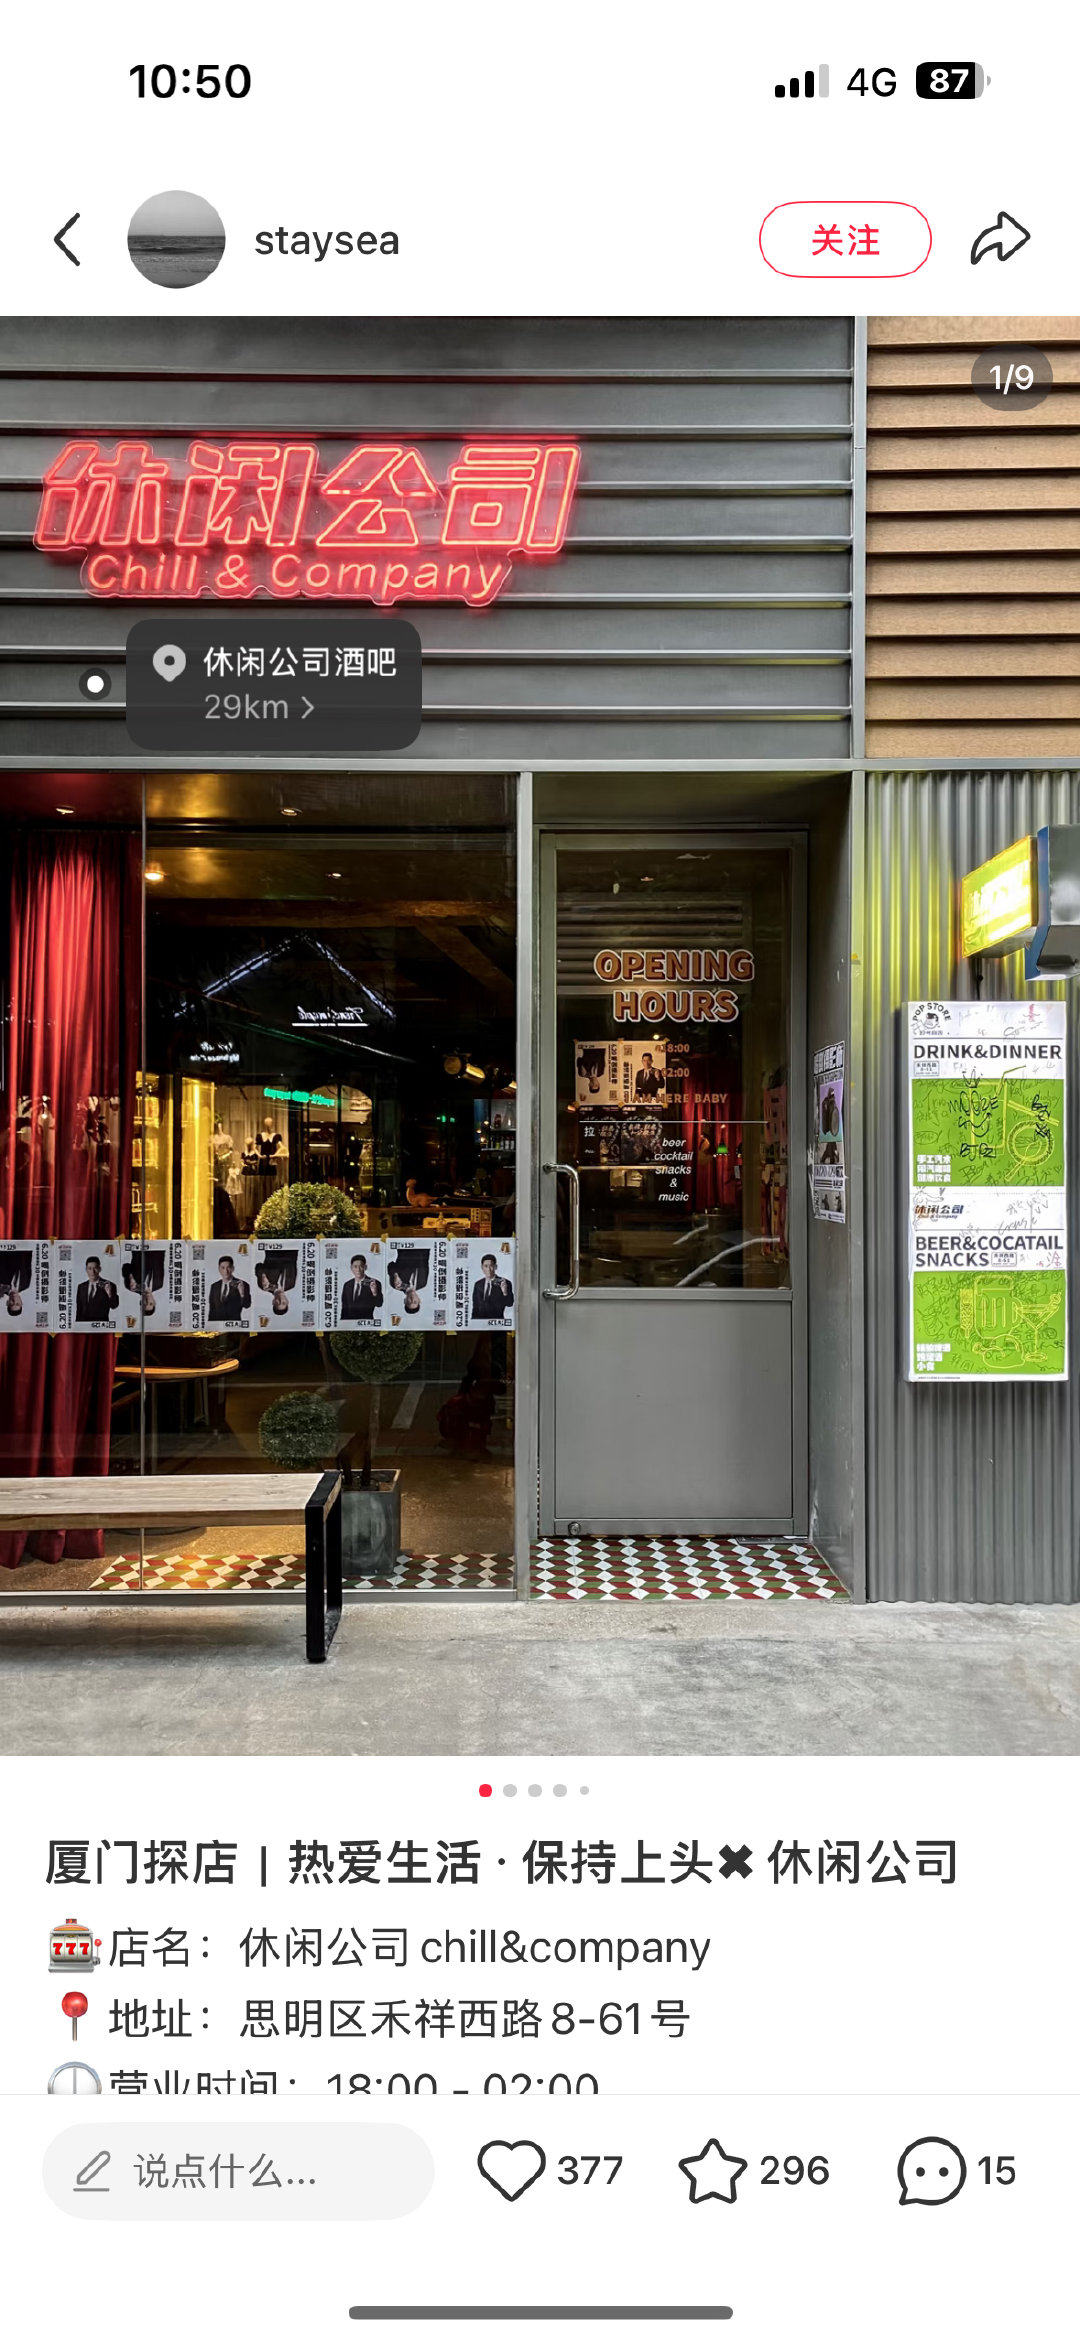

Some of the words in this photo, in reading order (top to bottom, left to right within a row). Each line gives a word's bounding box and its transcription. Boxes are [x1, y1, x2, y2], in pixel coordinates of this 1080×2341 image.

[36, 441, 580, 548] 休闲公司
[87, 553, 198, 590] Chill
[216, 553, 247, 590] &
[272, 553, 501, 599] Company
[593, 949, 755, 982] OPENING
[612, 989, 739, 1023] HOURS
[914, 1044, 1062, 1060] DRINK&DINNER
[661, 1068, 690, 1078] 02:00
[656, 1093, 690, 1104] HERE
[694, 1093, 728, 1104] BABY
[584, 1126, 596, 1137] 拉
[662, 1138, 687, 1148] beer
[654, 1152, 694, 1161] cocktail
[655, 1165, 692, 1175] snacks
[669, 1178, 678, 1188] &
[658, 1192, 690, 1202] music
[915, 1204, 965, 1215] 休闲公司
[915, 1235, 1064, 1251] BEER&COCATAIL
[915, 1252, 989, 1267] SNACKS
